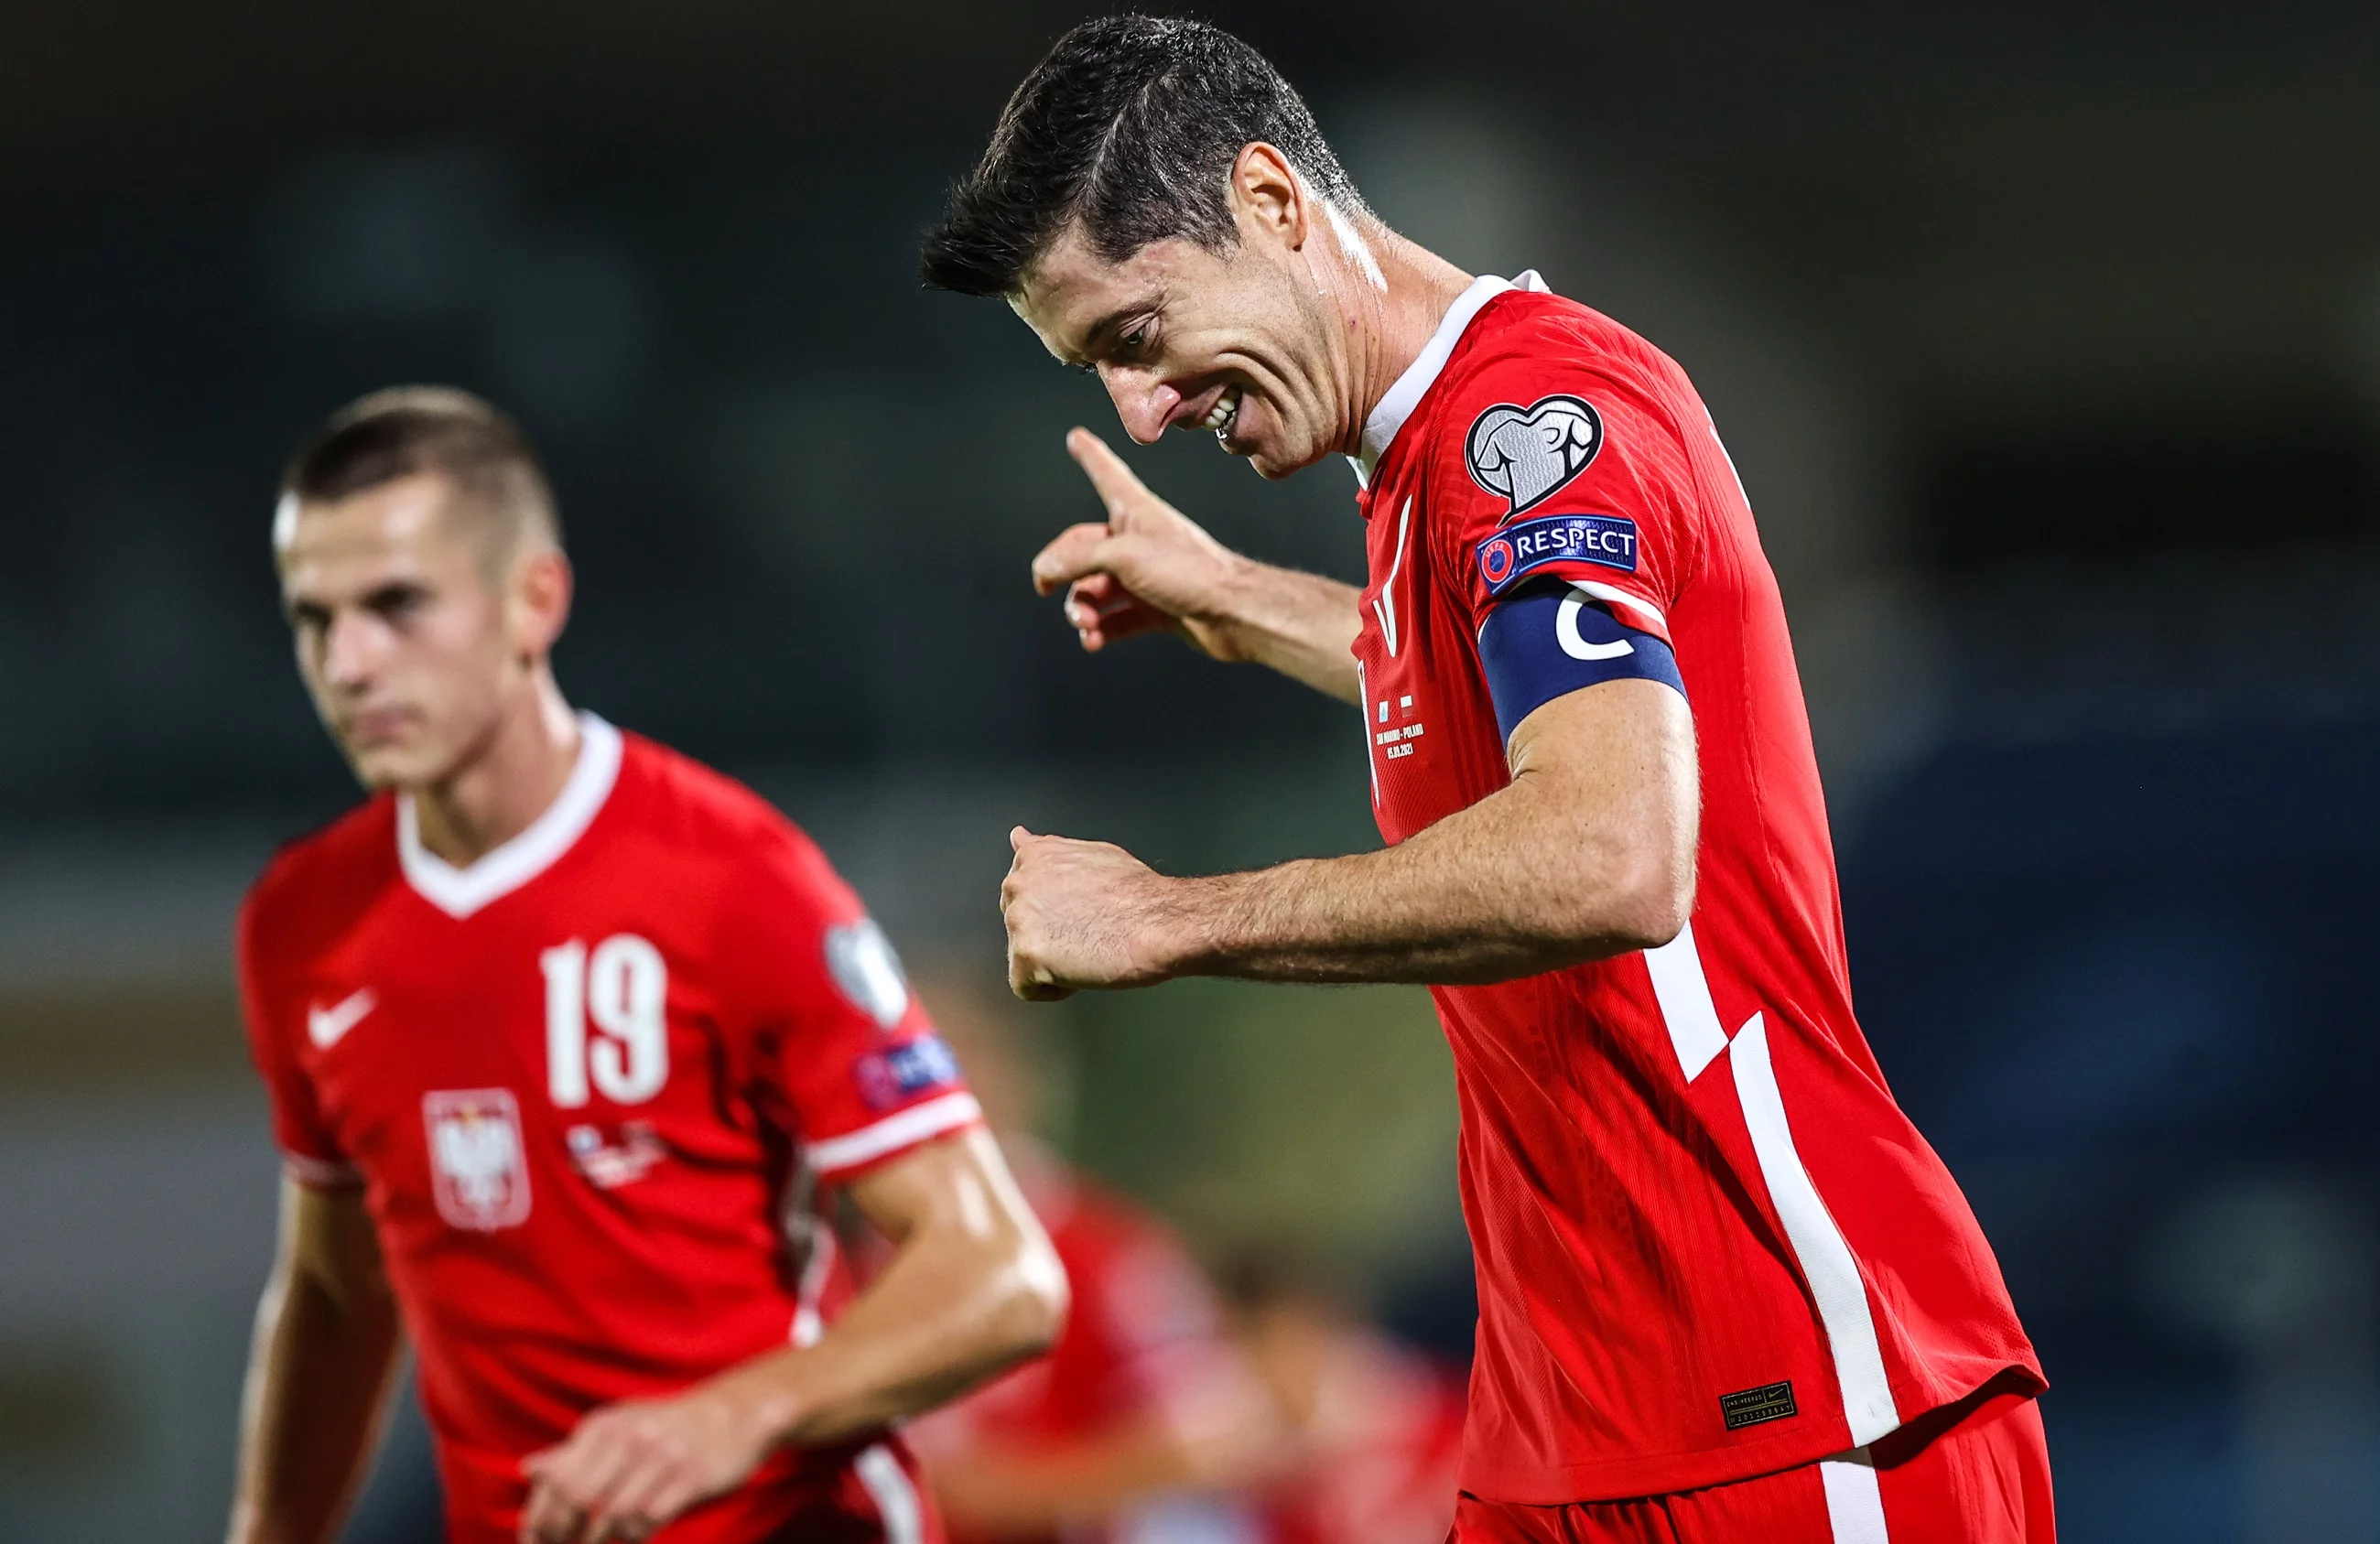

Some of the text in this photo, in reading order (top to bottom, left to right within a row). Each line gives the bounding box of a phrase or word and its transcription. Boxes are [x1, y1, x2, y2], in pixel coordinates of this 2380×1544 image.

[1486, 542, 1504, 558] UEFA
[1516, 528, 1635, 559] RESPECT
[1555, 588, 1635, 661] C
[1402, 723, 1424, 739] POLAND
[539, 932, 670, 1109] 19
